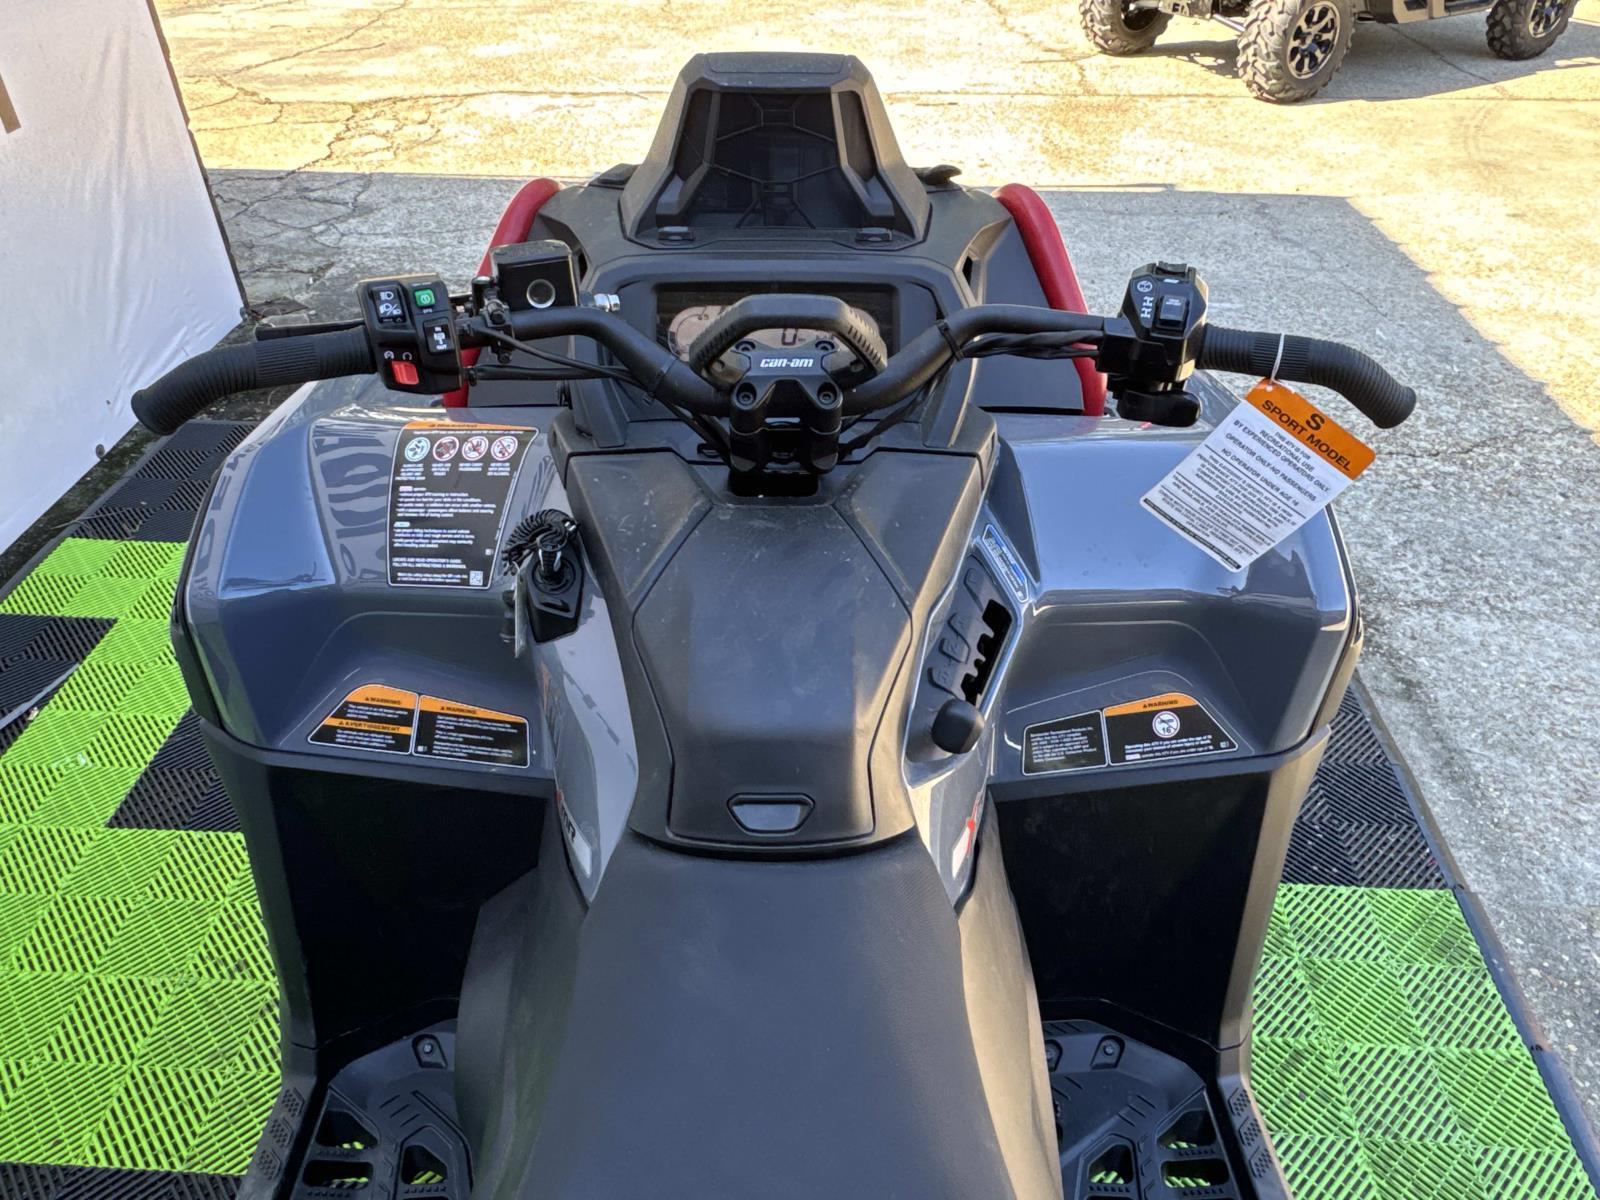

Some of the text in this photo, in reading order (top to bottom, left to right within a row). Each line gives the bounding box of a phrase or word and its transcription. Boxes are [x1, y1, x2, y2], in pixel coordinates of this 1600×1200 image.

[760, 358, 814, 368] can-am
[1259, 398, 1355, 471] SPORT MODEL
[1305, 413, 1326, 431] S
[1224, 432, 1257, 457] OPERATOR
[1278, 472, 1318, 501] PASSENGERS
[1232, 419, 1243, 429] BY
[1240, 426, 1282, 457] EXPERIENCED
[1279, 454, 1315, 481] OPERATORS
[1258, 429, 1302, 462] RECREATIONAL
[1220, 447, 1232, 457] NO
[1229, 454, 1261, 478] OPERATOR
[1258, 475, 1281, 492] UNDER
